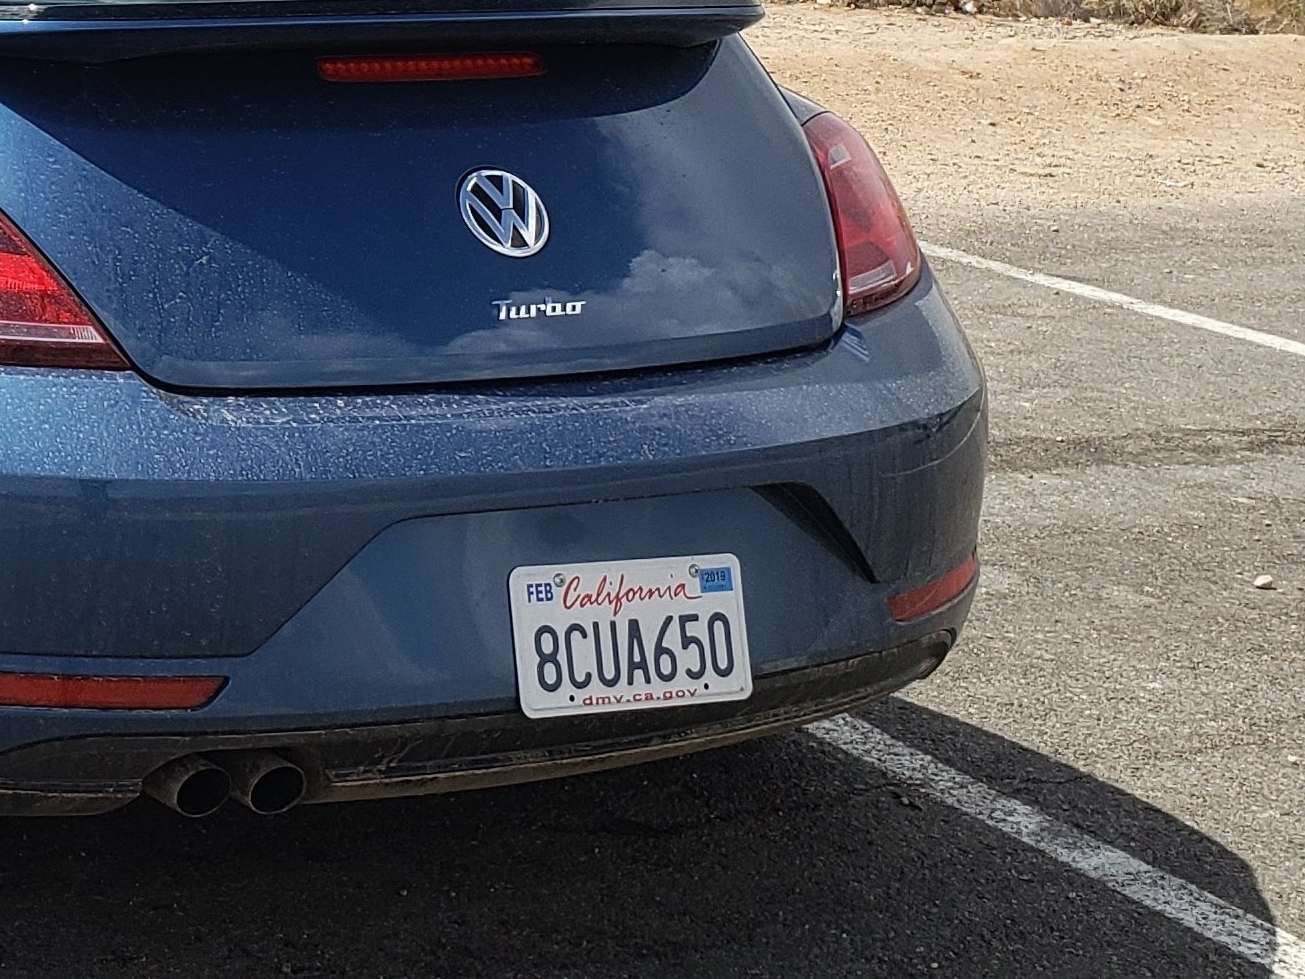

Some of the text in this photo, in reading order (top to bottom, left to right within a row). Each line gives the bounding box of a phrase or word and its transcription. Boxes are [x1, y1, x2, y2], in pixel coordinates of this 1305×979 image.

[491, 297, 587, 321] Turbo
[704, 570, 726, 583] 2019
[526, 582, 554, 603] FEB
[562, 574, 703, 617] California
[534, 611, 734, 693] 8CUA650
[582, 687, 698, 706] dmv.ca.gov
